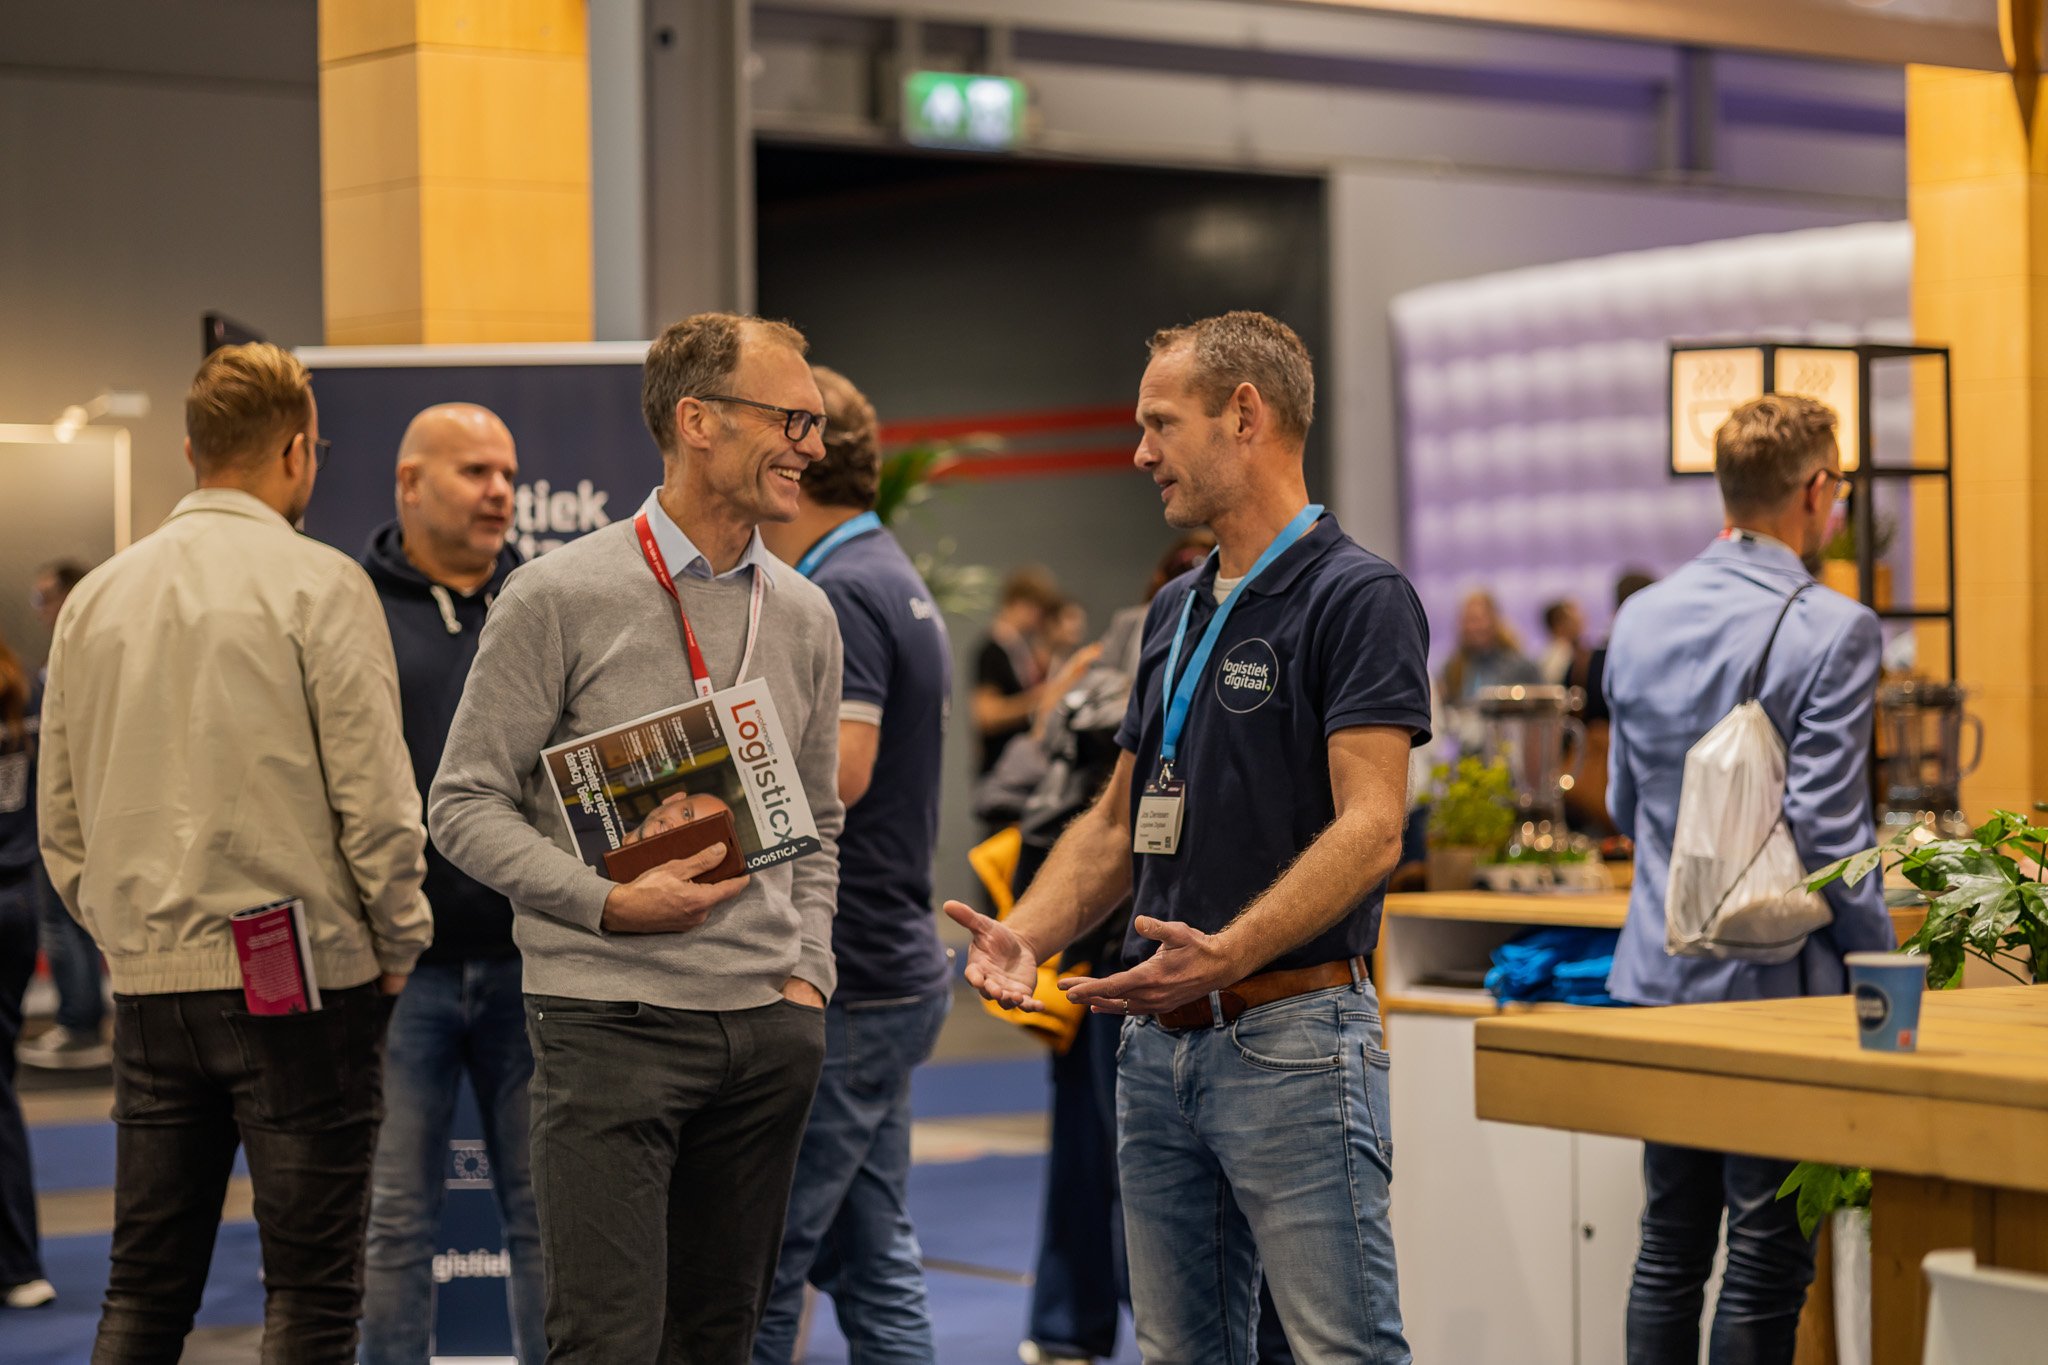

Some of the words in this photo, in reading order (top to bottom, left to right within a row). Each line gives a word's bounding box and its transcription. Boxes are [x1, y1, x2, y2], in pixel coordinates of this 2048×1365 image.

[511, 479, 612, 533] tiek
[1223, 658, 1269, 677] logistiek
[577, 746, 600, 793] Efficiënter
[730, 699, 796, 845] Logisticx
[747, 845, 798, 869] LOGISTICA
